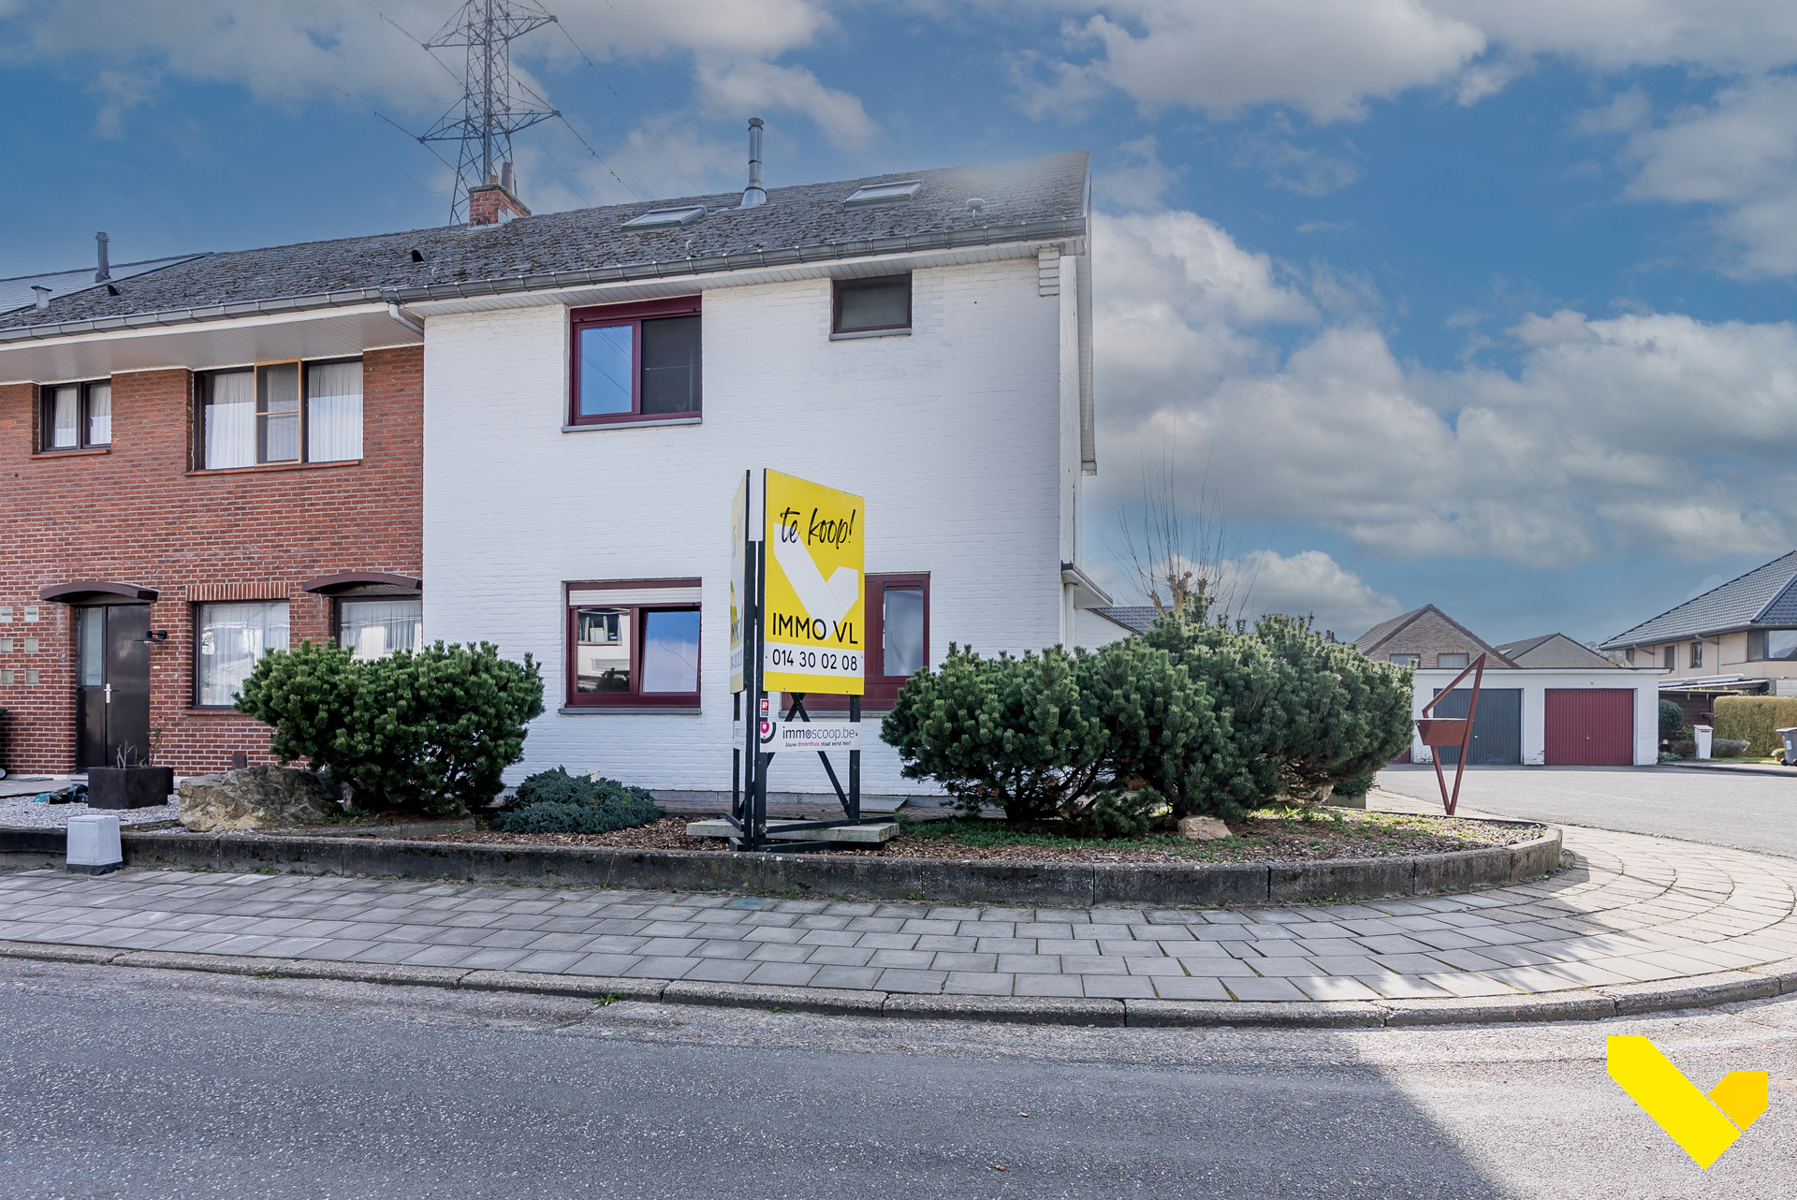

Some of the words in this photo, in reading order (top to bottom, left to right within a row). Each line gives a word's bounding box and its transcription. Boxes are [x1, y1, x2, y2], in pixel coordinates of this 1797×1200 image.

[780, 507, 801, 543] te
[808, 508, 855, 550] koop!
[773, 612, 826, 640] IMMO
[833, 620, 858, 644] VL
[772, 648, 794, 666] 014
[799, 651, 816, 668] 30
[821, 653, 837, 669] 02
[841, 655, 858, 671] 08
[782, 726, 855, 741] immoscoop.be
